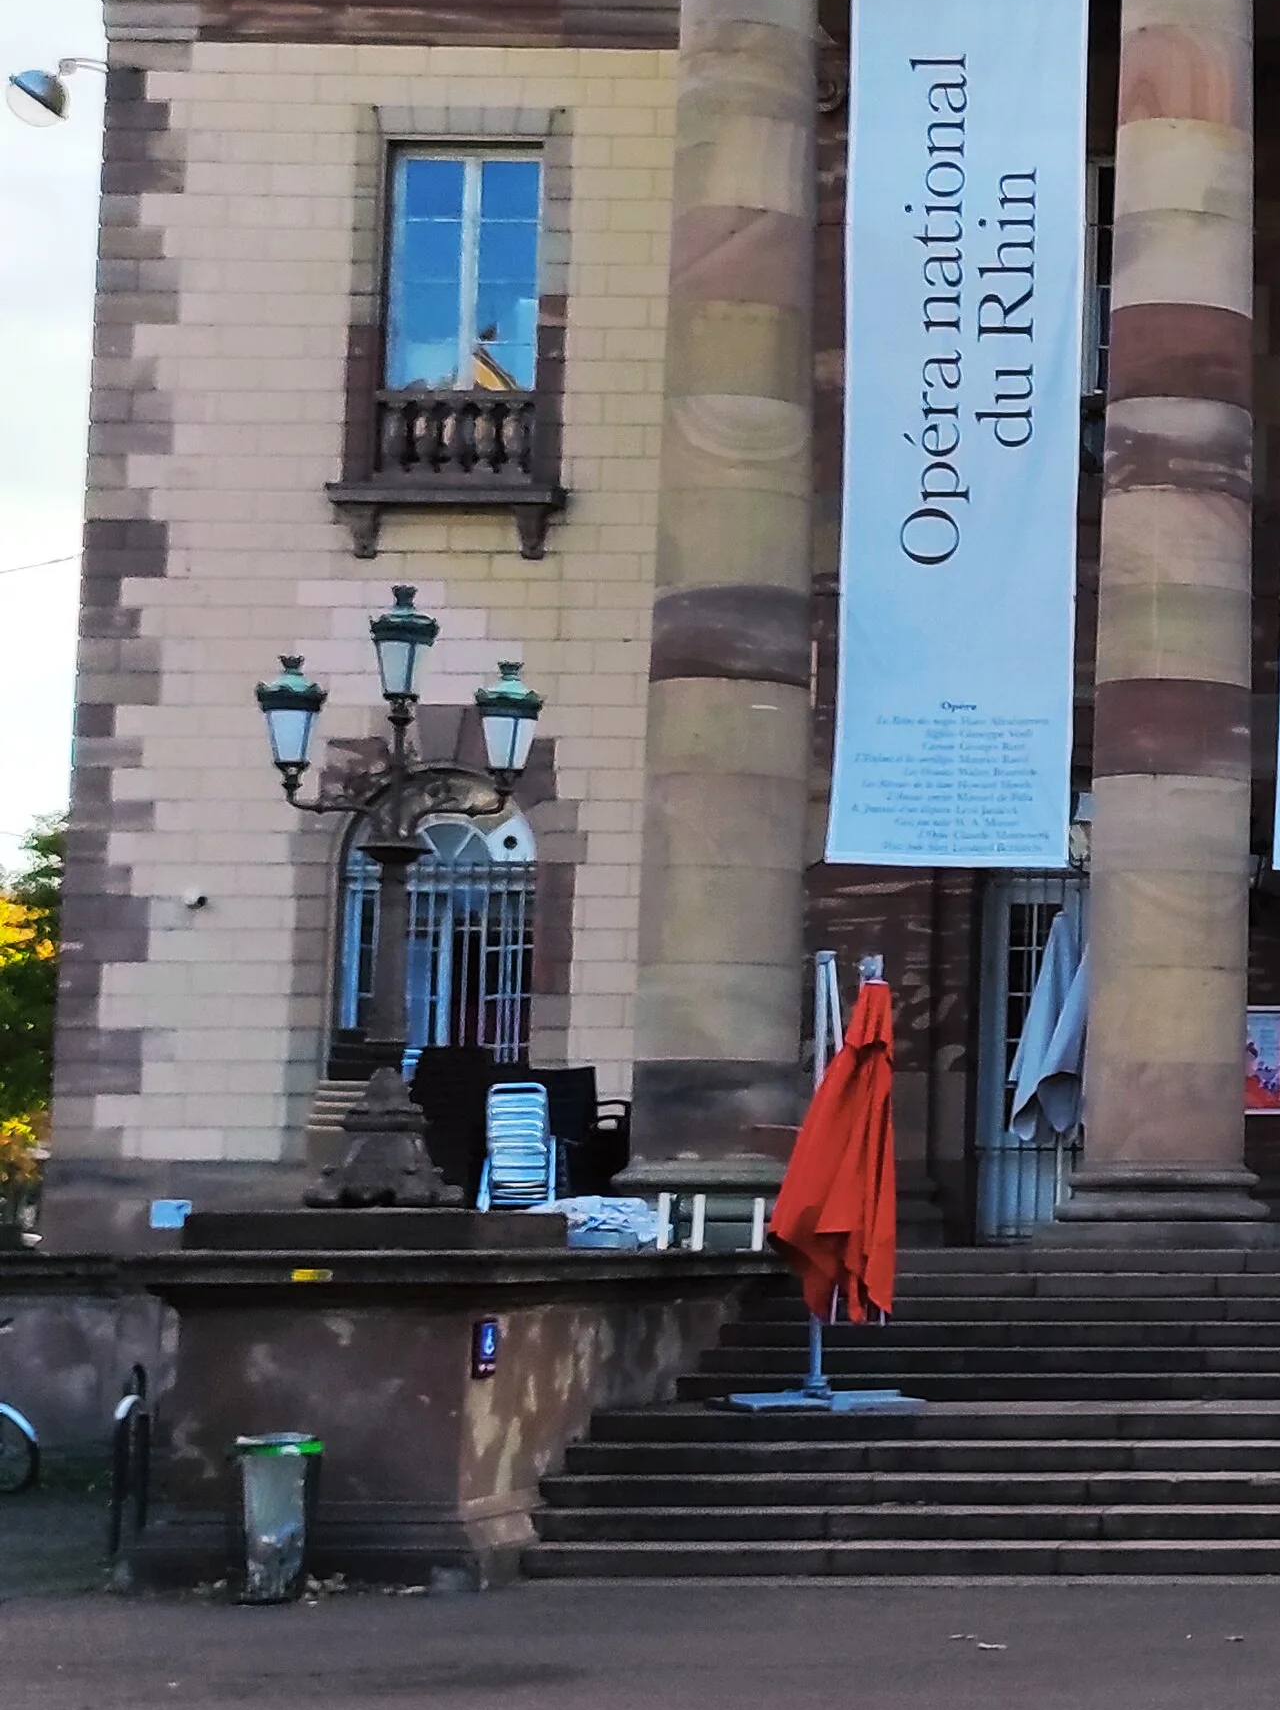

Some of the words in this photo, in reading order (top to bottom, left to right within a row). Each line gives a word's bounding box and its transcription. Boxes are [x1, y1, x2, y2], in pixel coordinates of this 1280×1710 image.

[905, 53, 968, 334] national
[977, 167, 1037, 343] Rhin
[900, 350, 970, 566] Opéra
[975, 365, 1035, 449] du
